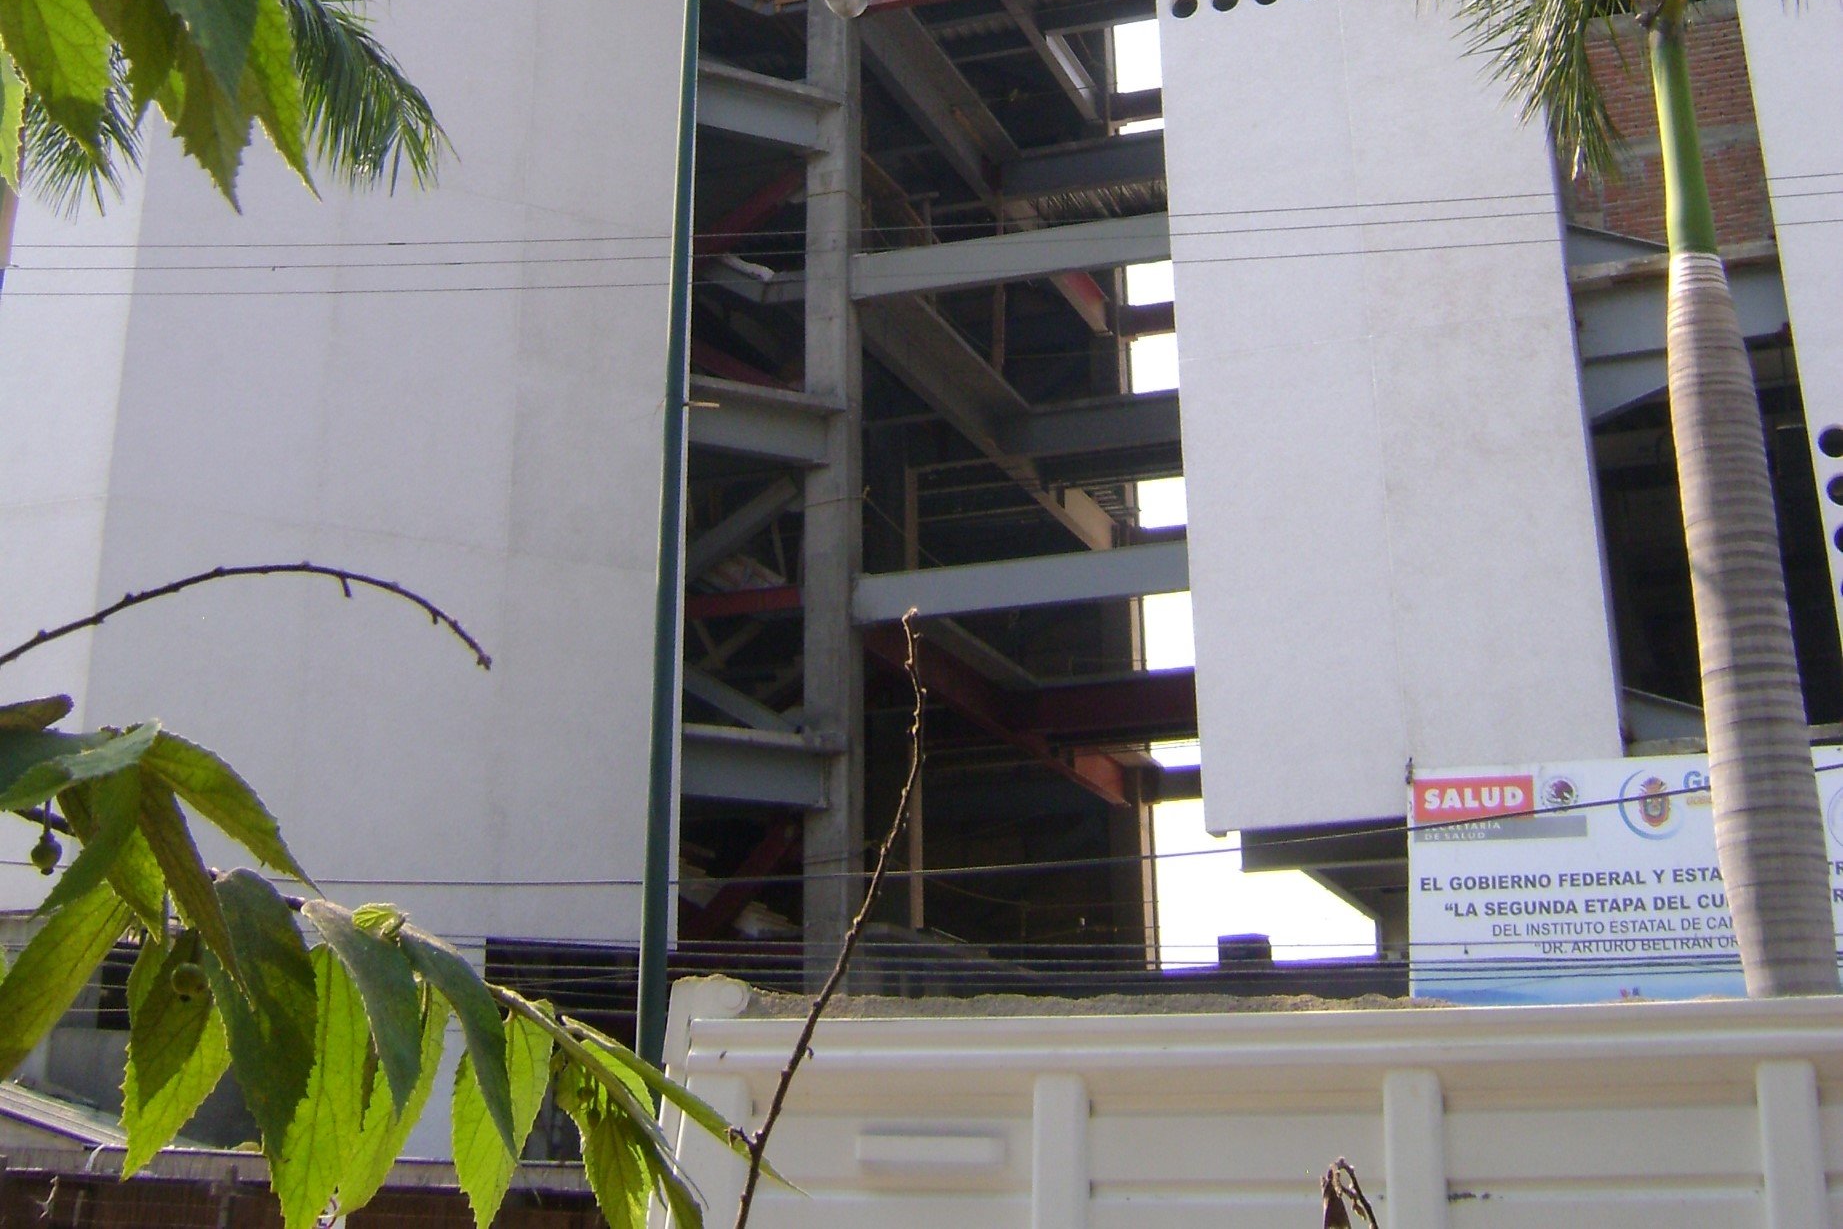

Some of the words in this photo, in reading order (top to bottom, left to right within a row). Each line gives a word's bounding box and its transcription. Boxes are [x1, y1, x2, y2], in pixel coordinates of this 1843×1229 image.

[1424, 786, 1524, 809] SALUD
[1425, 821, 1501, 831] RETARÍA
[1445, 832, 1486, 840] SALUD
[1421, 877, 1443, 891] EL
[1450, 874, 1551, 890] GOBIERNO
[1559, 870, 1646, 888] FEDERAL
[1652, 869, 1665, 884] Y
[1673, 867, 1724, 882] ESTA
[1484, 900, 1578, 916] SEGUNDA
[1584, 897, 1647, 913] ETAPA
[1653, 895, 1690, 911] DEL
[1697, 894, 1730, 909] CU
[1492, 924, 1522, 937] DEL
[1526, 921, 1605, 936] INSTITUTO
[1609, 918, 1676, 934] ESTATAL
[1681, 917, 1702, 931] DE
[1571, 938, 1636, 954] ARTURO
[1641, 933, 1713, 952] BELTRÁN
[1718, 935, 1740, 949] OR
